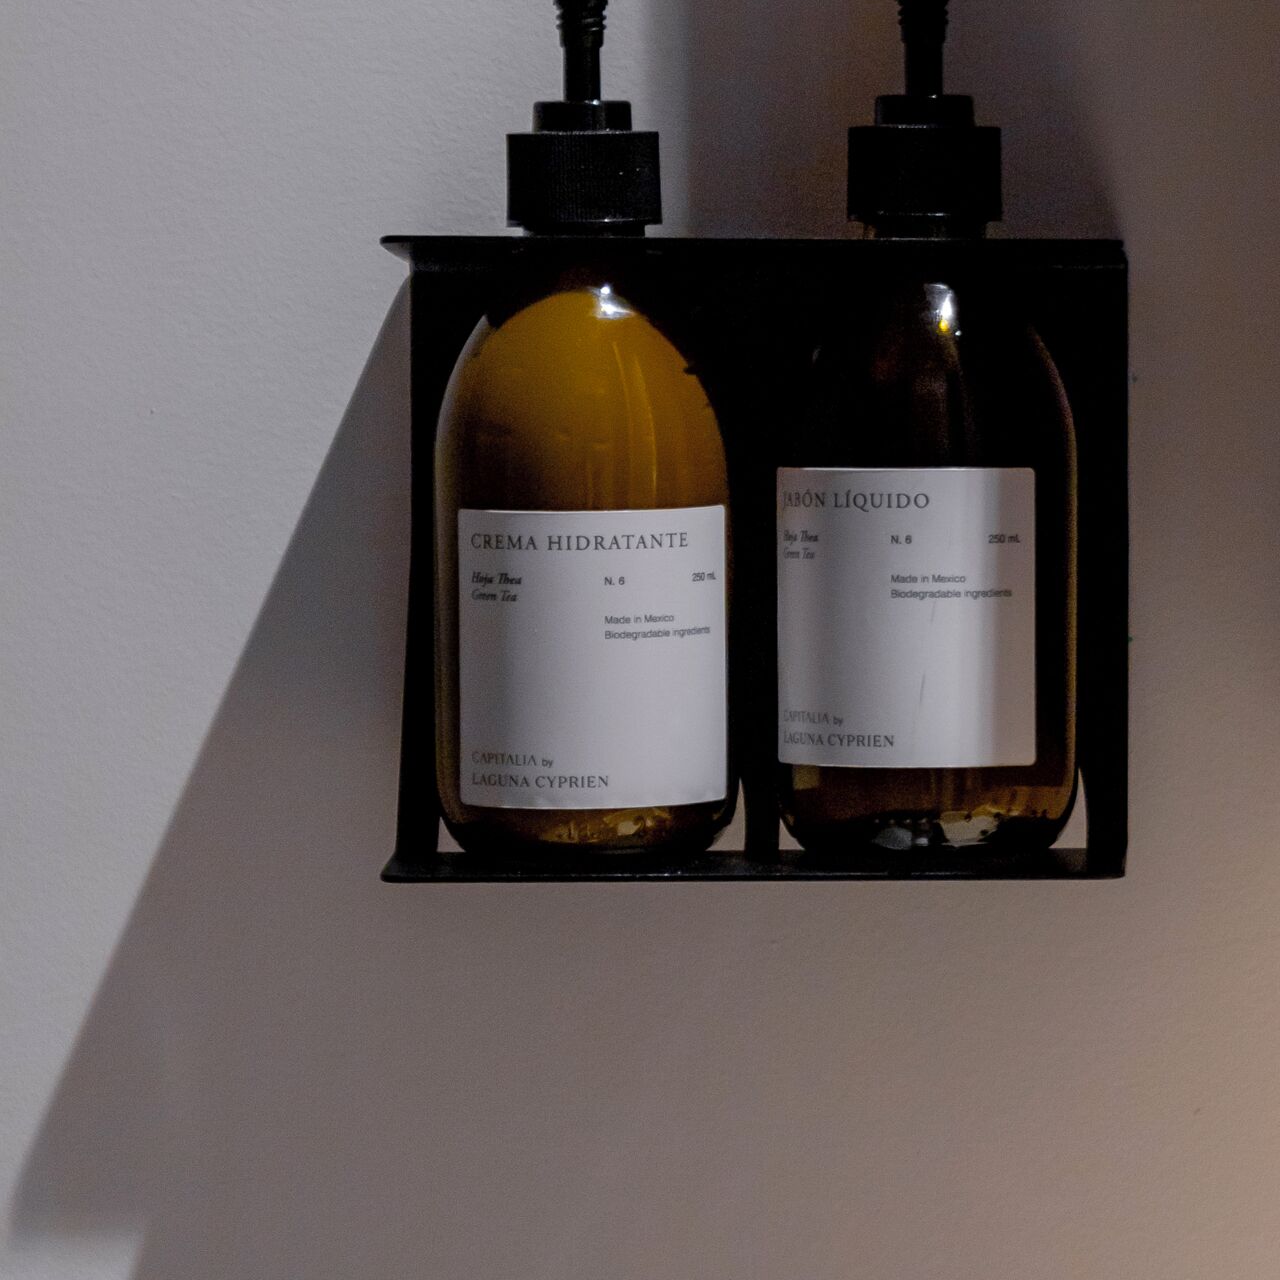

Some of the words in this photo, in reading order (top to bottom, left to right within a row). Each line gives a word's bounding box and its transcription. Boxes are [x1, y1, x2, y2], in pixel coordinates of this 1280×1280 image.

[783, 488, 826, 510] JABÓN
[834, 489, 930, 512] LÍQUIDO
[471, 532, 538, 551] CREMA
[547, 532, 689, 551] HIDRATANTE
[891, 535, 902, 545] N.
[905, 535, 912, 545] 6
[988, 534, 1006, 544] 250
[604, 576, 615, 586] N.
[618, 576, 626, 586] 6
[692, 572, 706, 582] 250
[891, 574, 918, 584] Made
[921, 574, 930, 584] in
[932, 574, 966, 584] Mexico
[501, 590, 518, 602] Tea
[891, 588, 961, 600] Biodegradable
[964, 588, 1013, 600] ingredients
[604, 615, 632, 625] Made
[634, 615, 642, 624] in
[644, 614, 675, 623] Mexico
[604, 629, 671, 641] Biodegradable
[672, 626, 712, 638] ingredients
[783, 729, 825, 746] LAGUNA
[828, 733, 895, 748] CYPRIEN
[471, 751, 537, 766] CAPITALIA
[541, 758, 554, 769] by
[471, 772, 530, 788] LAGUNA
[535, 775, 609, 789] CYPRIEN
